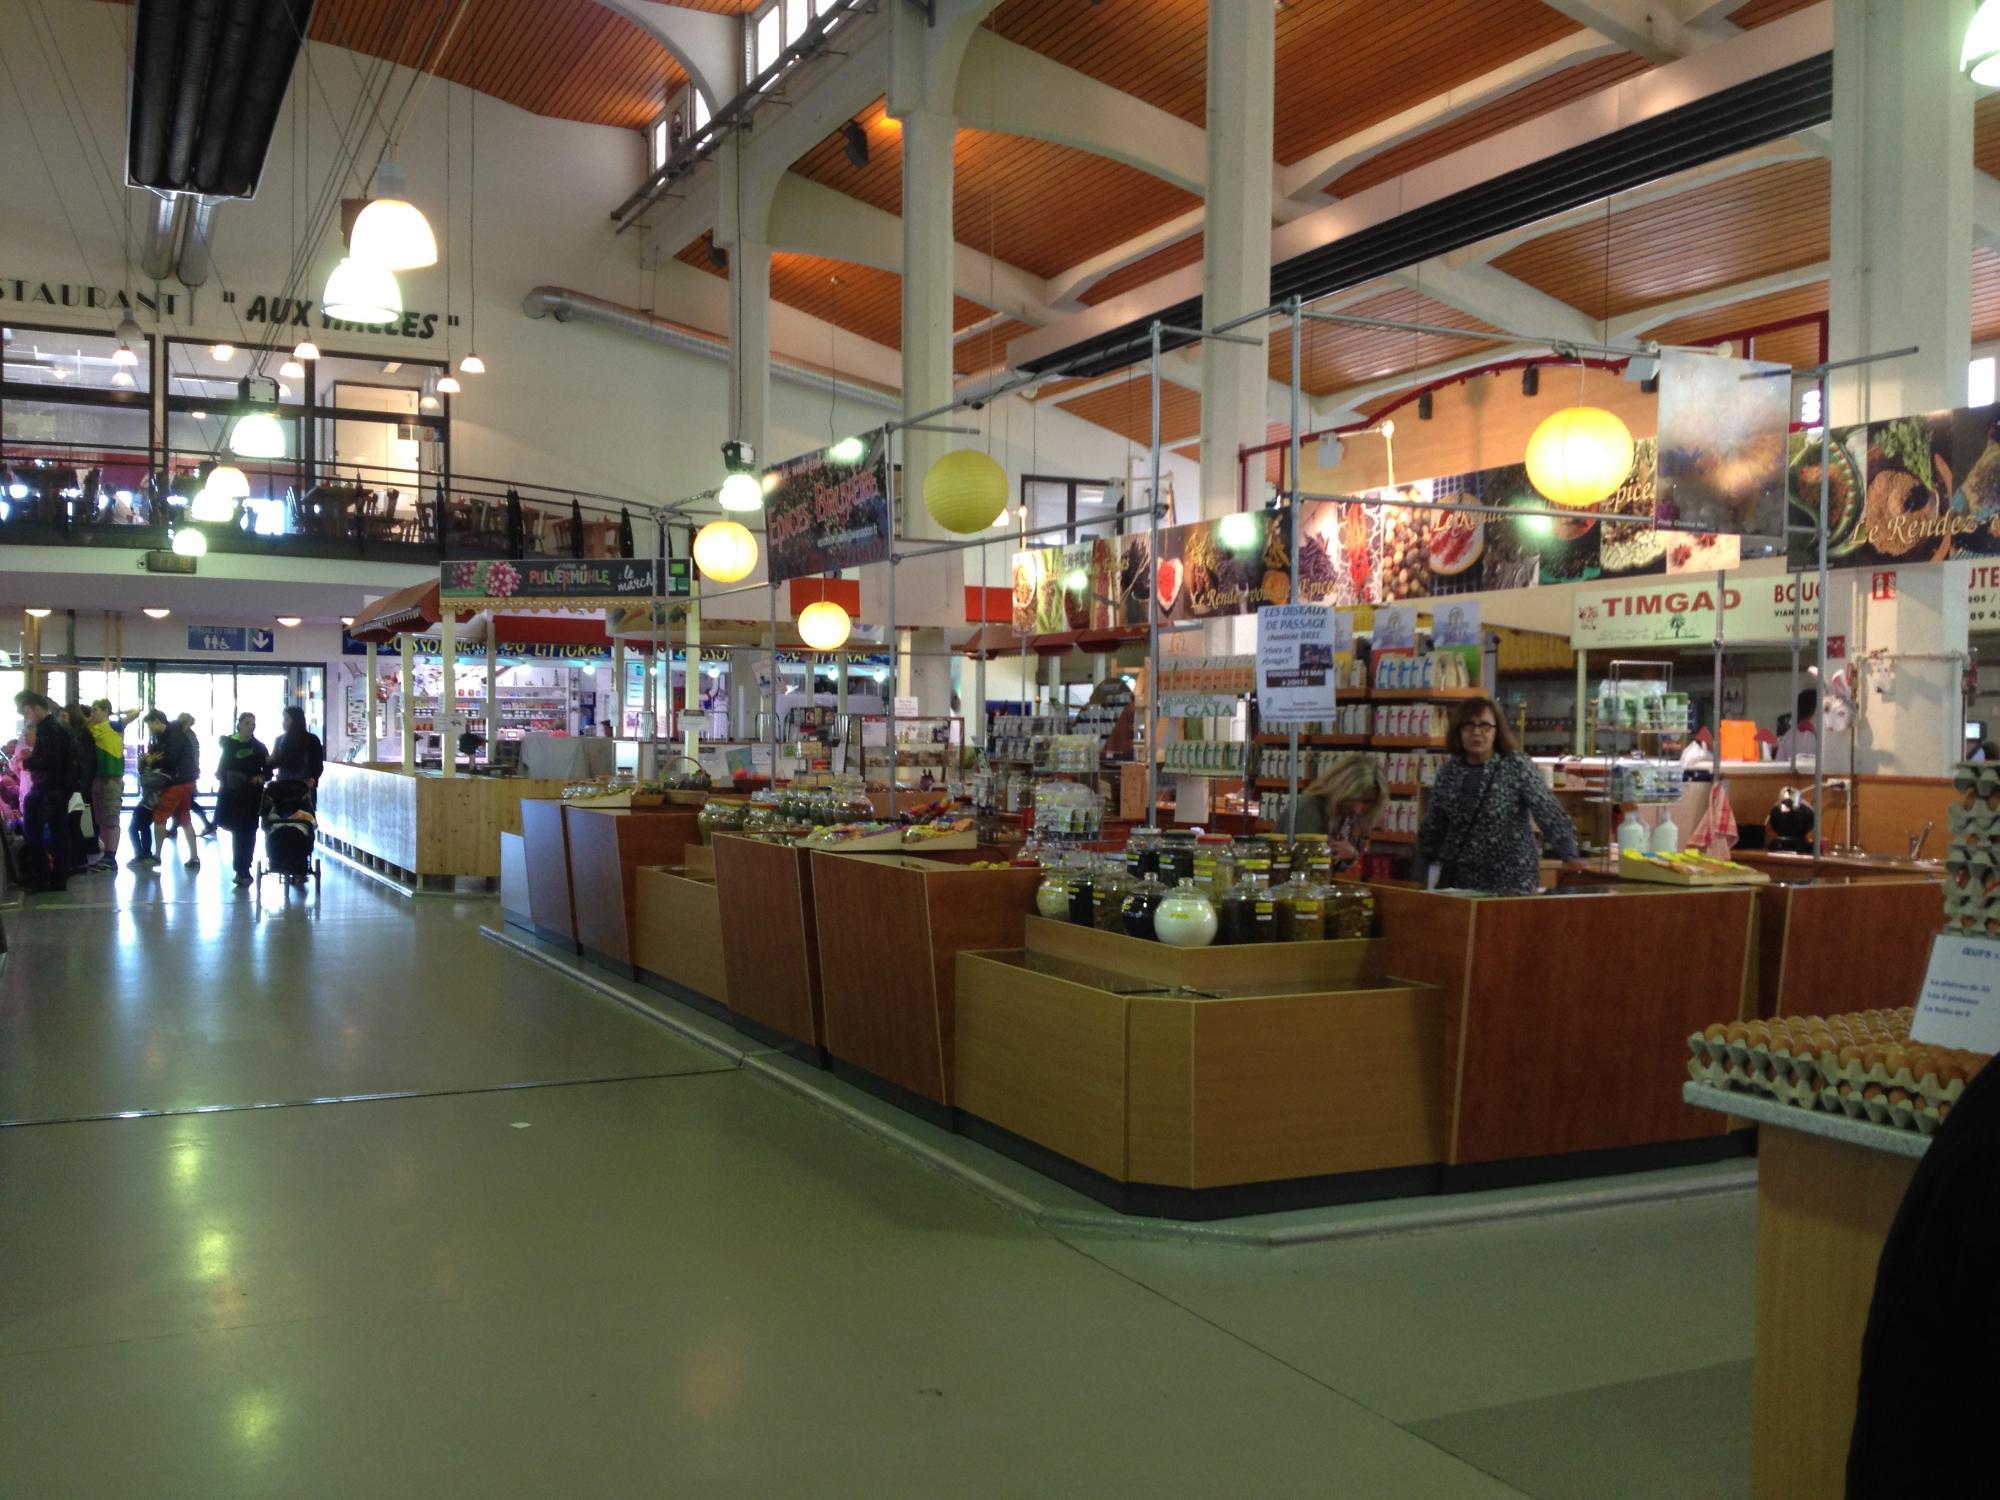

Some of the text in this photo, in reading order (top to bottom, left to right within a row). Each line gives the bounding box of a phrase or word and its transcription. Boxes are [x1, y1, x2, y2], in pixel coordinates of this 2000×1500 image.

[0, 278, 180, 315] TAURANT
[1850, 520, 1879, 545] Le
[528, 563, 613, 592] PULVERMÜHLE
[617, 571, 658, 592] march
[623, 564, 635, 580] le
[1190, 591, 1206, 609] Le
[1602, 589, 1742, 617] TIMGAD
[1264, 606, 1328, 618] LES OISEAUX
[1266, 618, 1327, 631] DE PASSAGE
